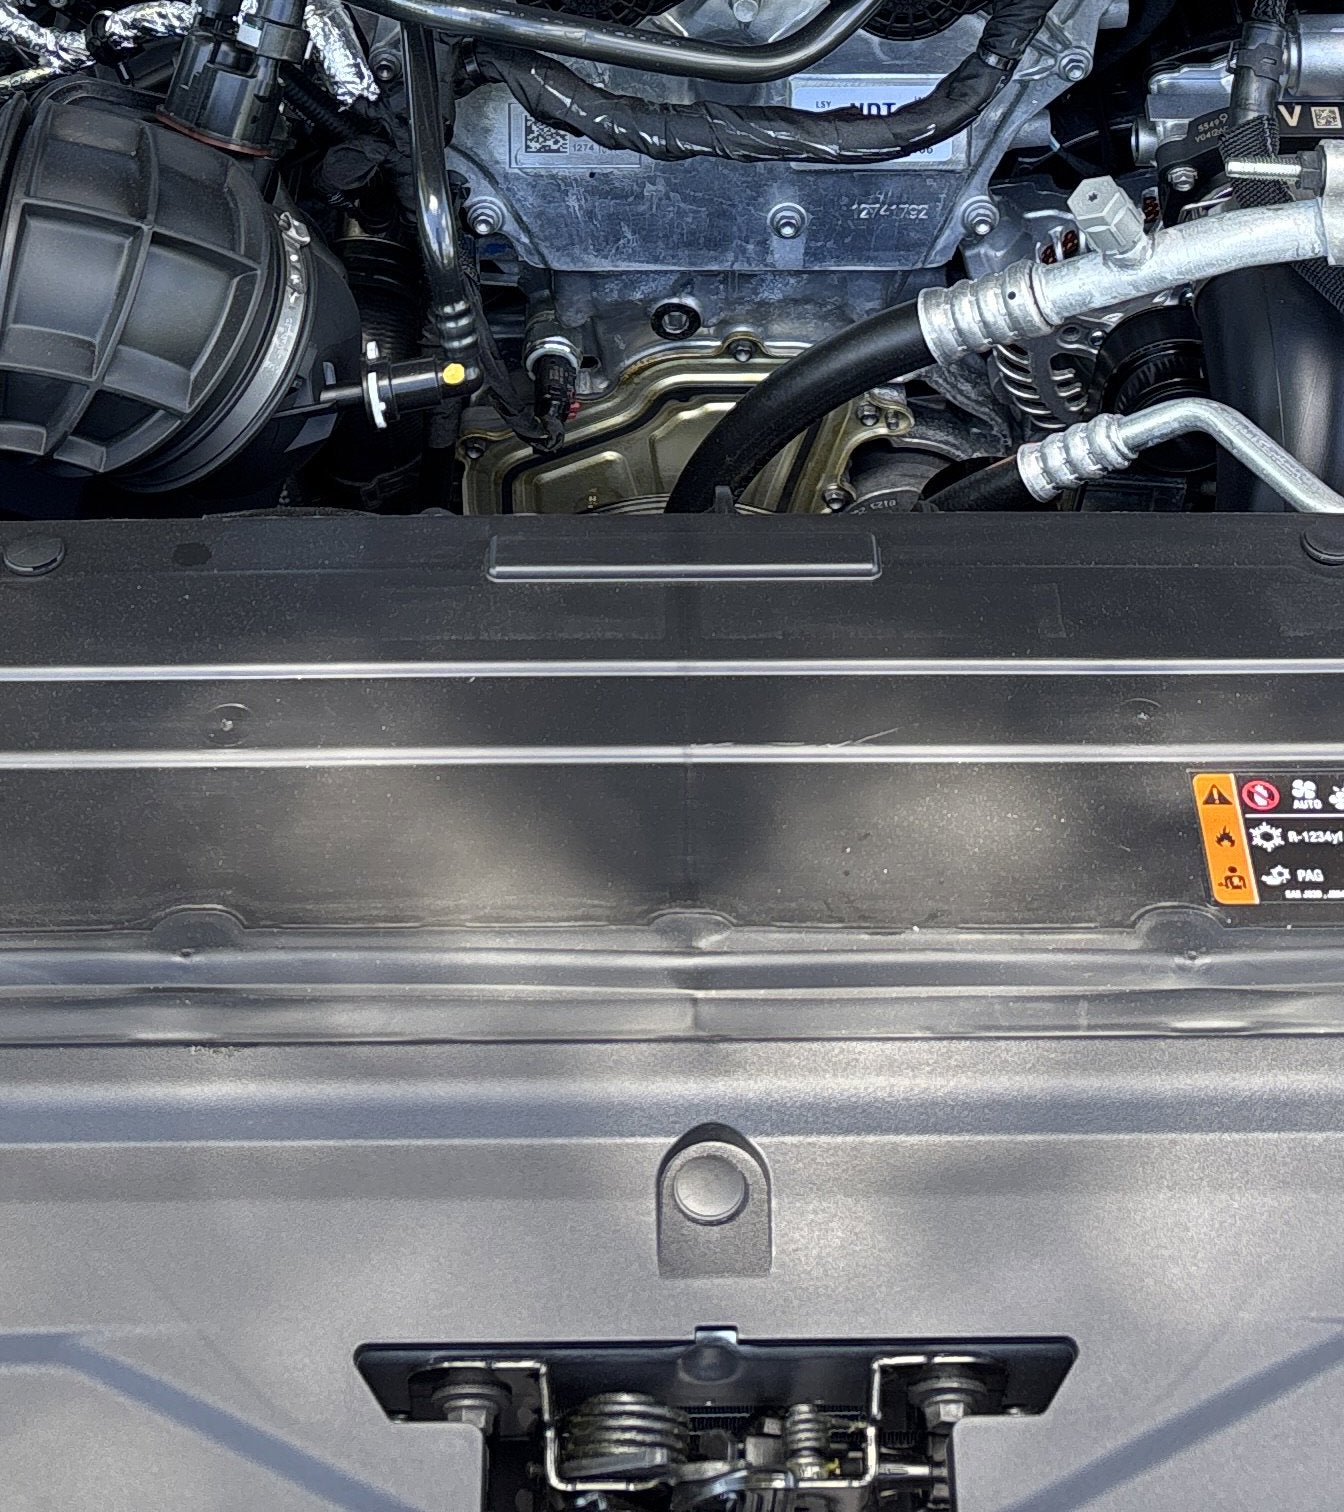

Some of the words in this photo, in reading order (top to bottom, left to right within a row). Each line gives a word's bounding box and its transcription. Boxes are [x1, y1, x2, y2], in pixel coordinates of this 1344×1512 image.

[815, 100, 832, 109] LSY
[1277, 105, 1302, 127] V
[1293, 799, 1323, 810] AUTO
[1296, 868, 1325, 882] PAG
